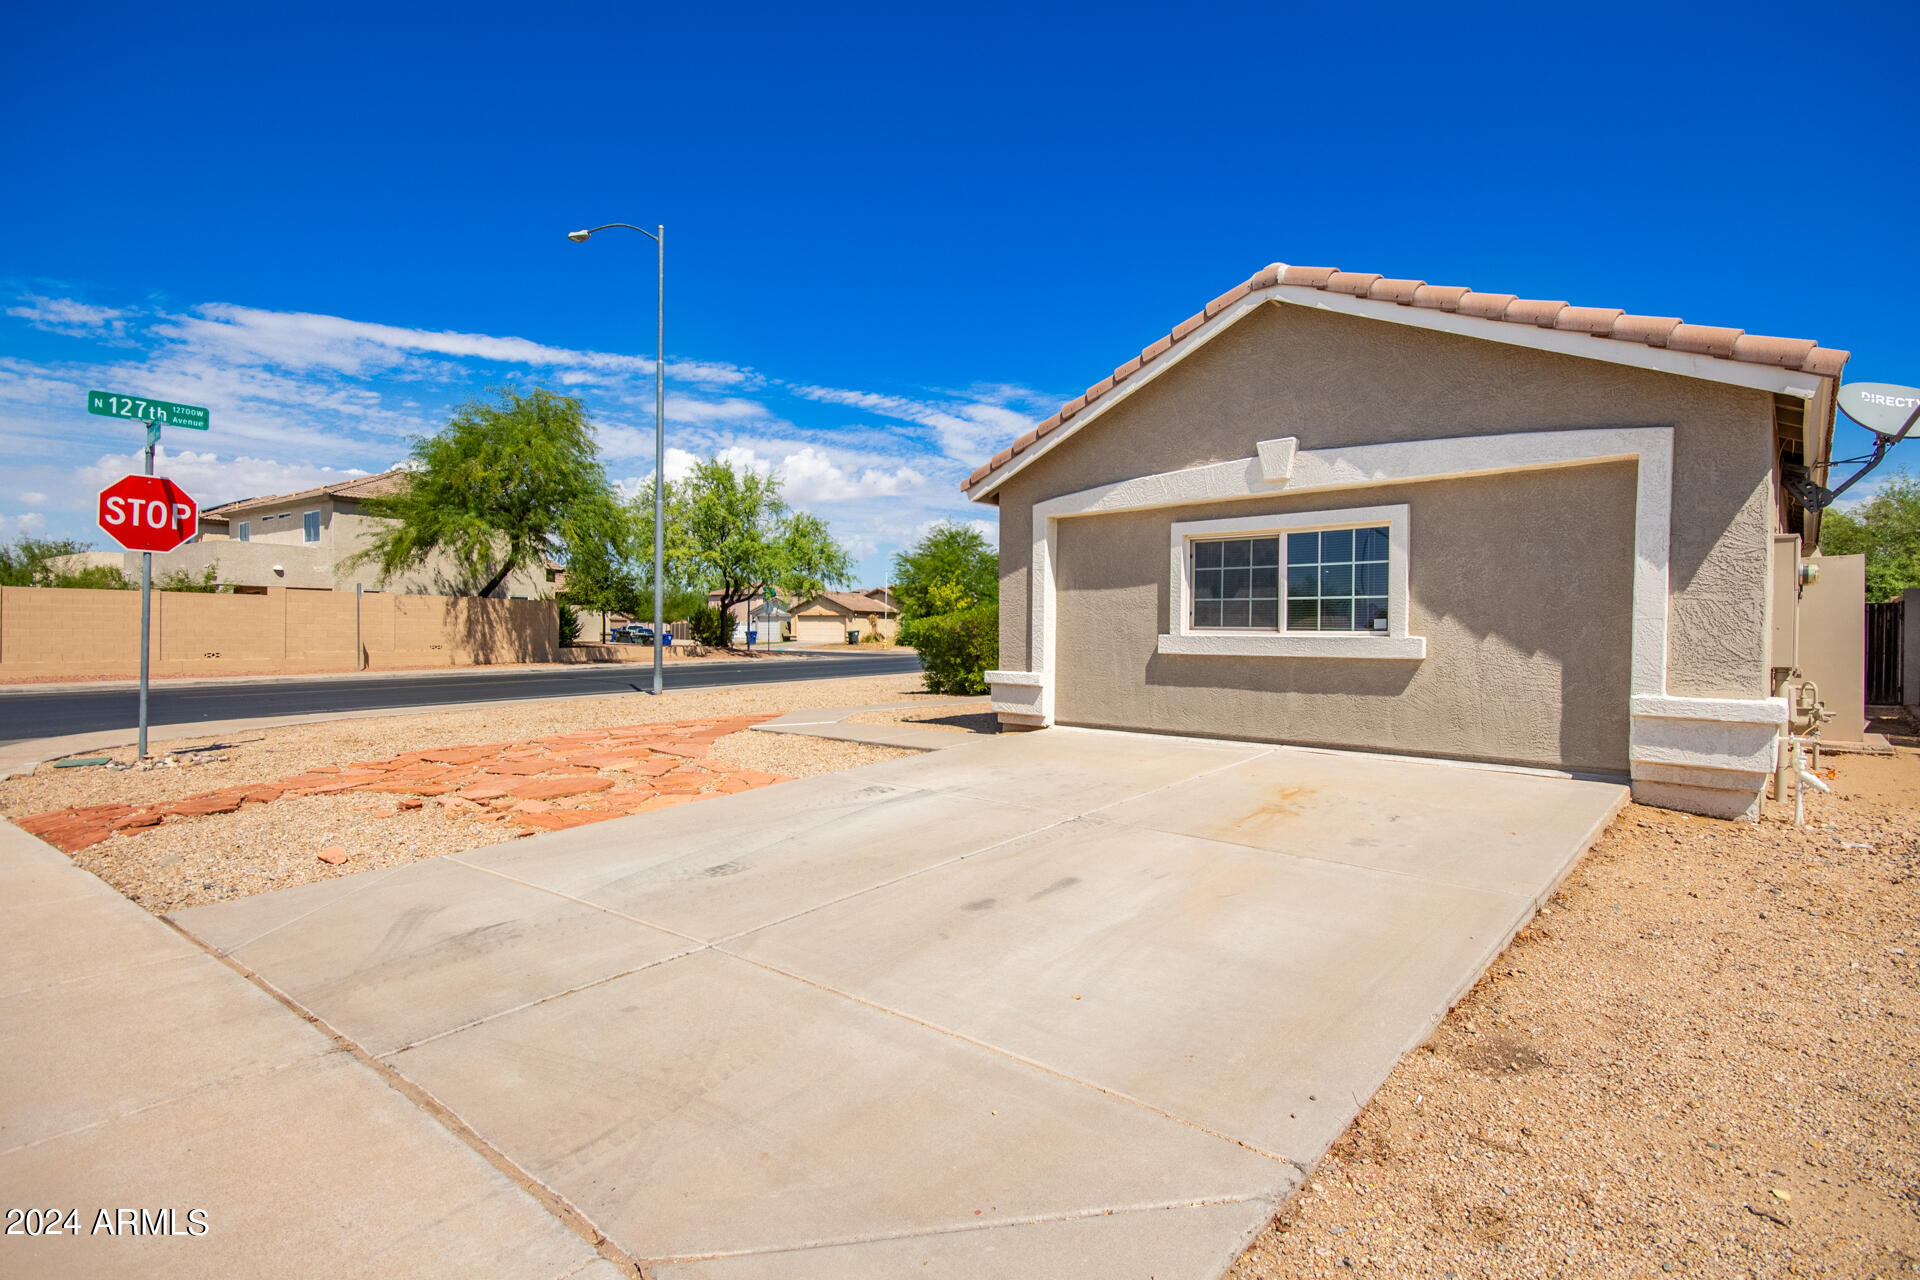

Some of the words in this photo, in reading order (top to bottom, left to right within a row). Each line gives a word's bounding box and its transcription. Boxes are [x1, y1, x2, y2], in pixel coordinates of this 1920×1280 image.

[94, 397, 103, 408] N
[109, 396, 167, 422] 127th
[172, 406, 204, 418] 12700W
[172, 417, 204, 427] Avenue
[105, 496, 191, 529] STOP
